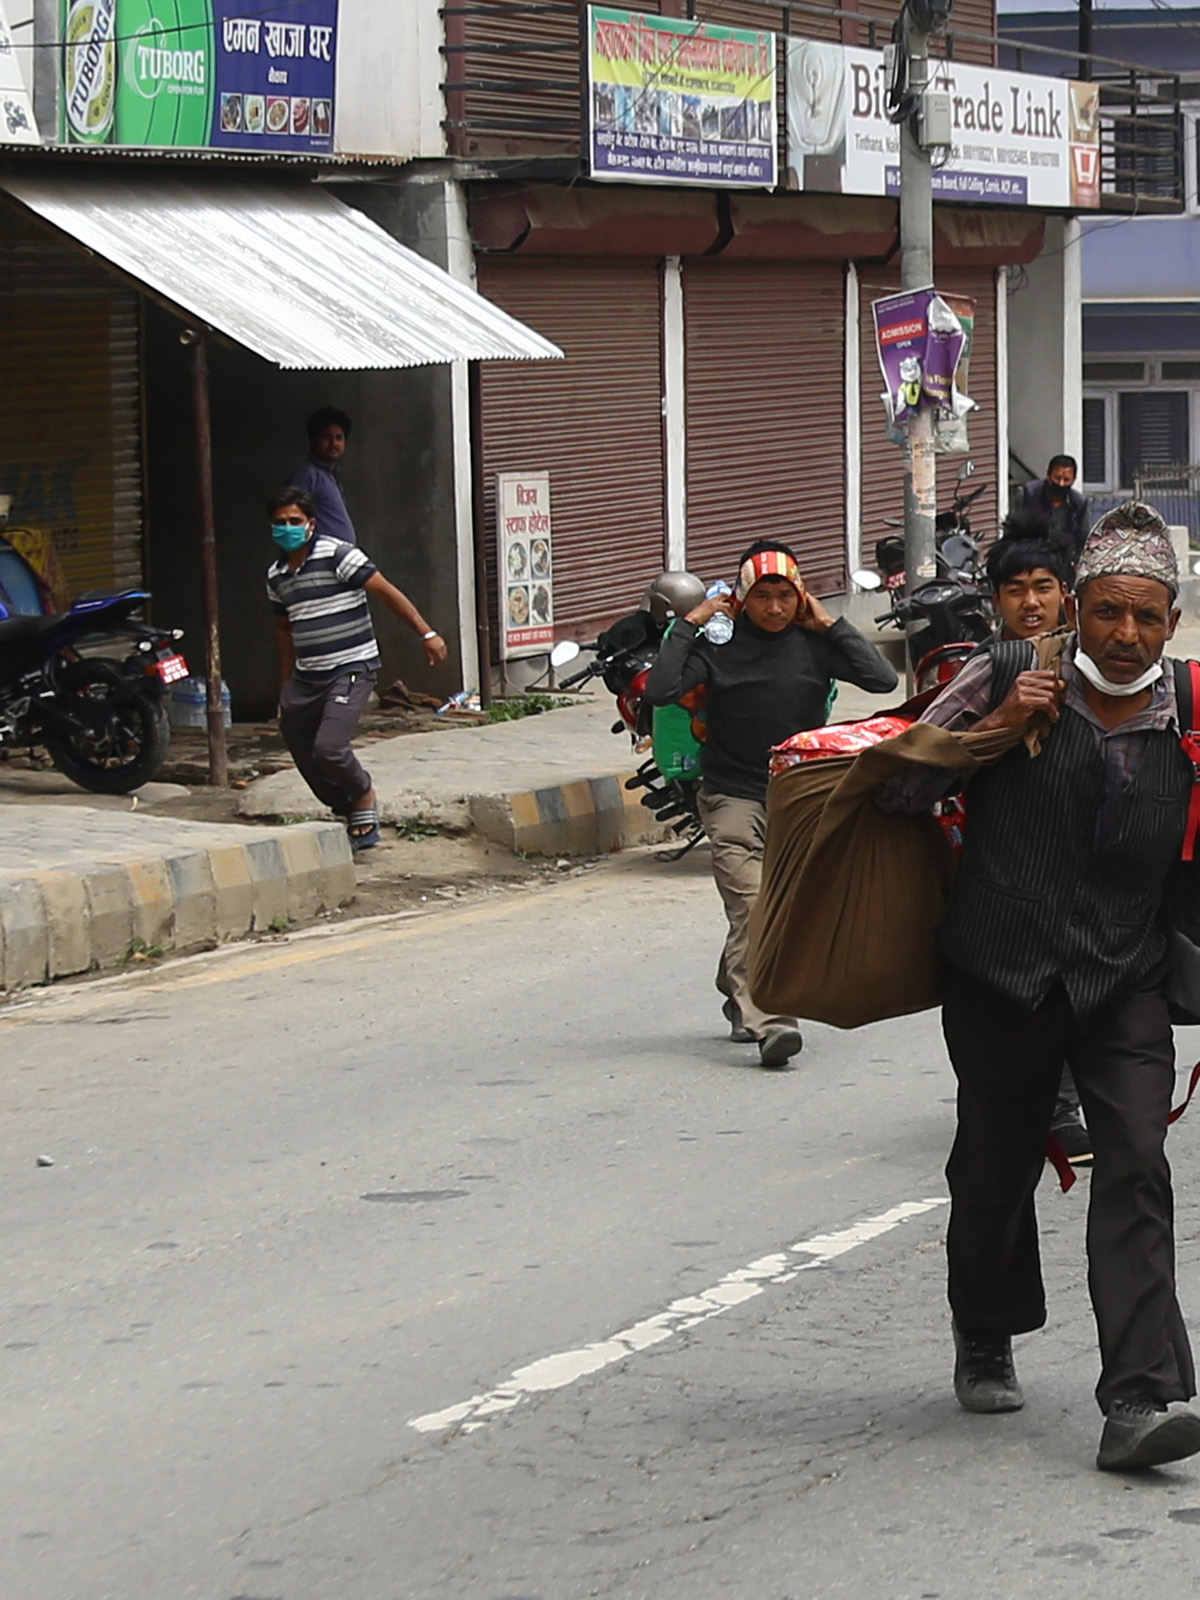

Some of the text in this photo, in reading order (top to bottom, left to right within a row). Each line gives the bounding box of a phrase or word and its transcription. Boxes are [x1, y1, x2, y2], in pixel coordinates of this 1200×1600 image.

[264, 21, 306, 57] खाजा
[309, 25, 333, 61] घर
[71, 8, 110, 120] TUBORG
[138, 46, 205, 84] TUBORG
[1010, 86, 1063, 139] Link
[881, 322, 923, 340] ADMISSION
[896, 340, 912, 349] OPEN
